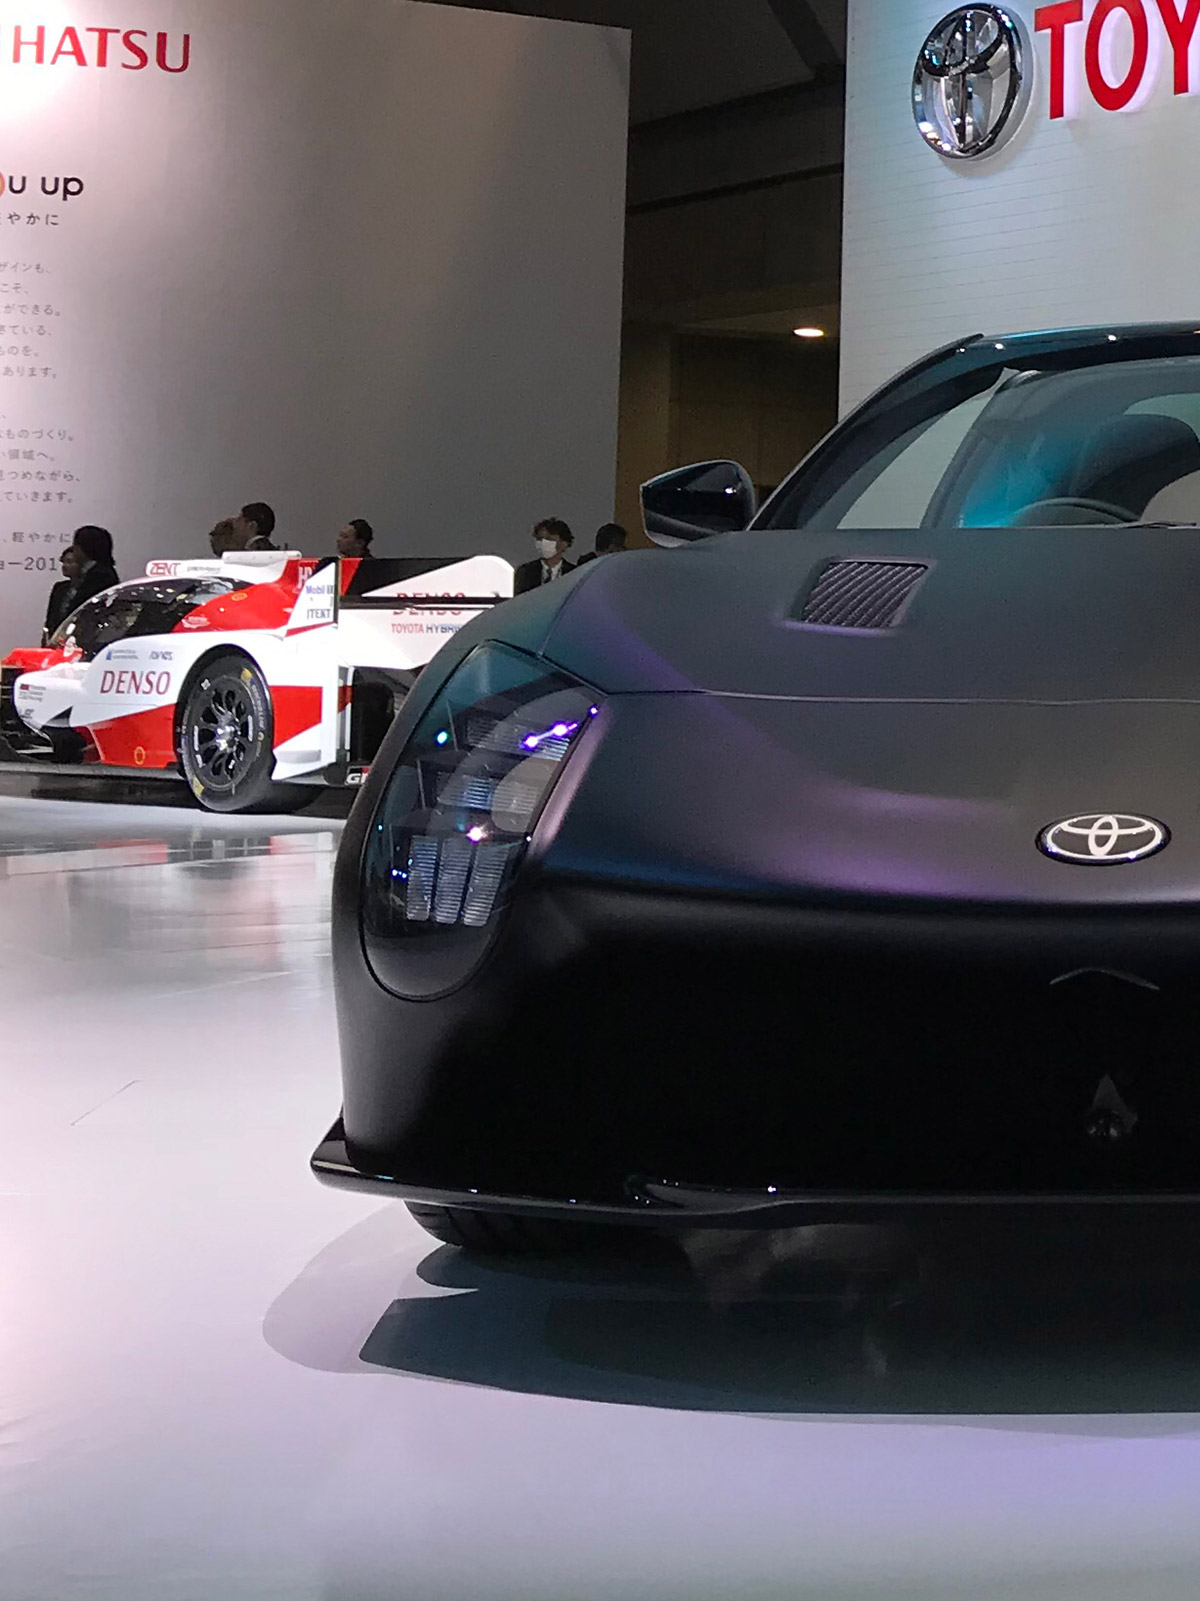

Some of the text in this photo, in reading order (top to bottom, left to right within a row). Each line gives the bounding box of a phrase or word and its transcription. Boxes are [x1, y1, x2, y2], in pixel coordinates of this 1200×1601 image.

[12, 25, 190, 73] HATSU
[0, 171, 84, 201] u up
[0, 212, 59, 226] やかに
[0, 429, 74, 442] ものづくり。
[391, 623, 462, 634] TOYOTA HYBRI
[100, 671, 171, 695] DENSO
